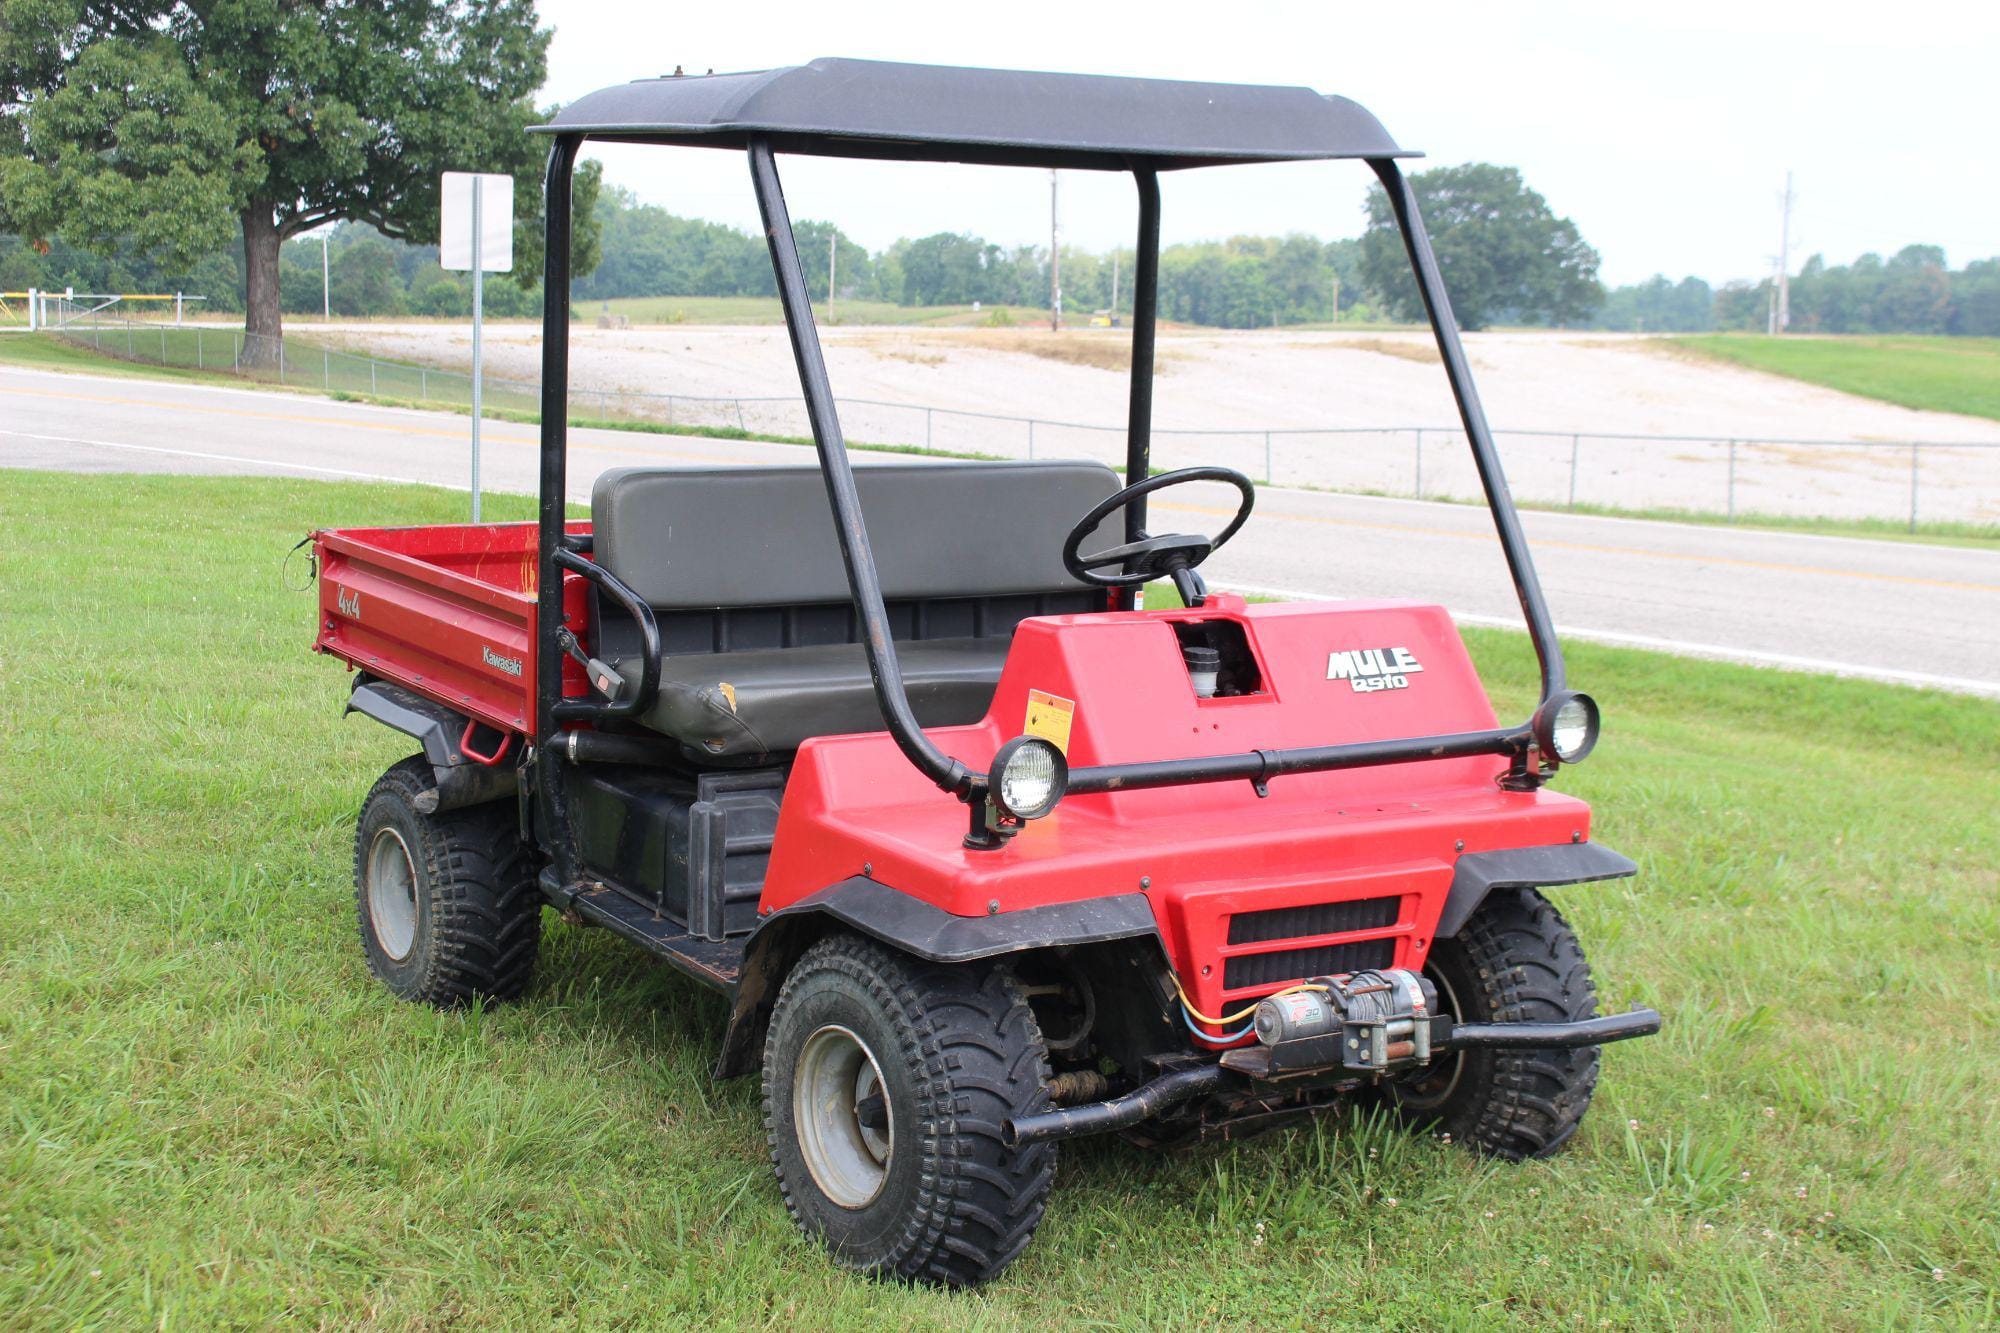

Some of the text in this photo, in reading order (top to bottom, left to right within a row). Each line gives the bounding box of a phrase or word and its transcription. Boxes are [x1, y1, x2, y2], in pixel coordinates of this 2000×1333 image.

[483, 646, 522, 677] Kawasaki
[1326, 647, 1424, 680] MULE
[1350, 674, 1409, 693] 2510
